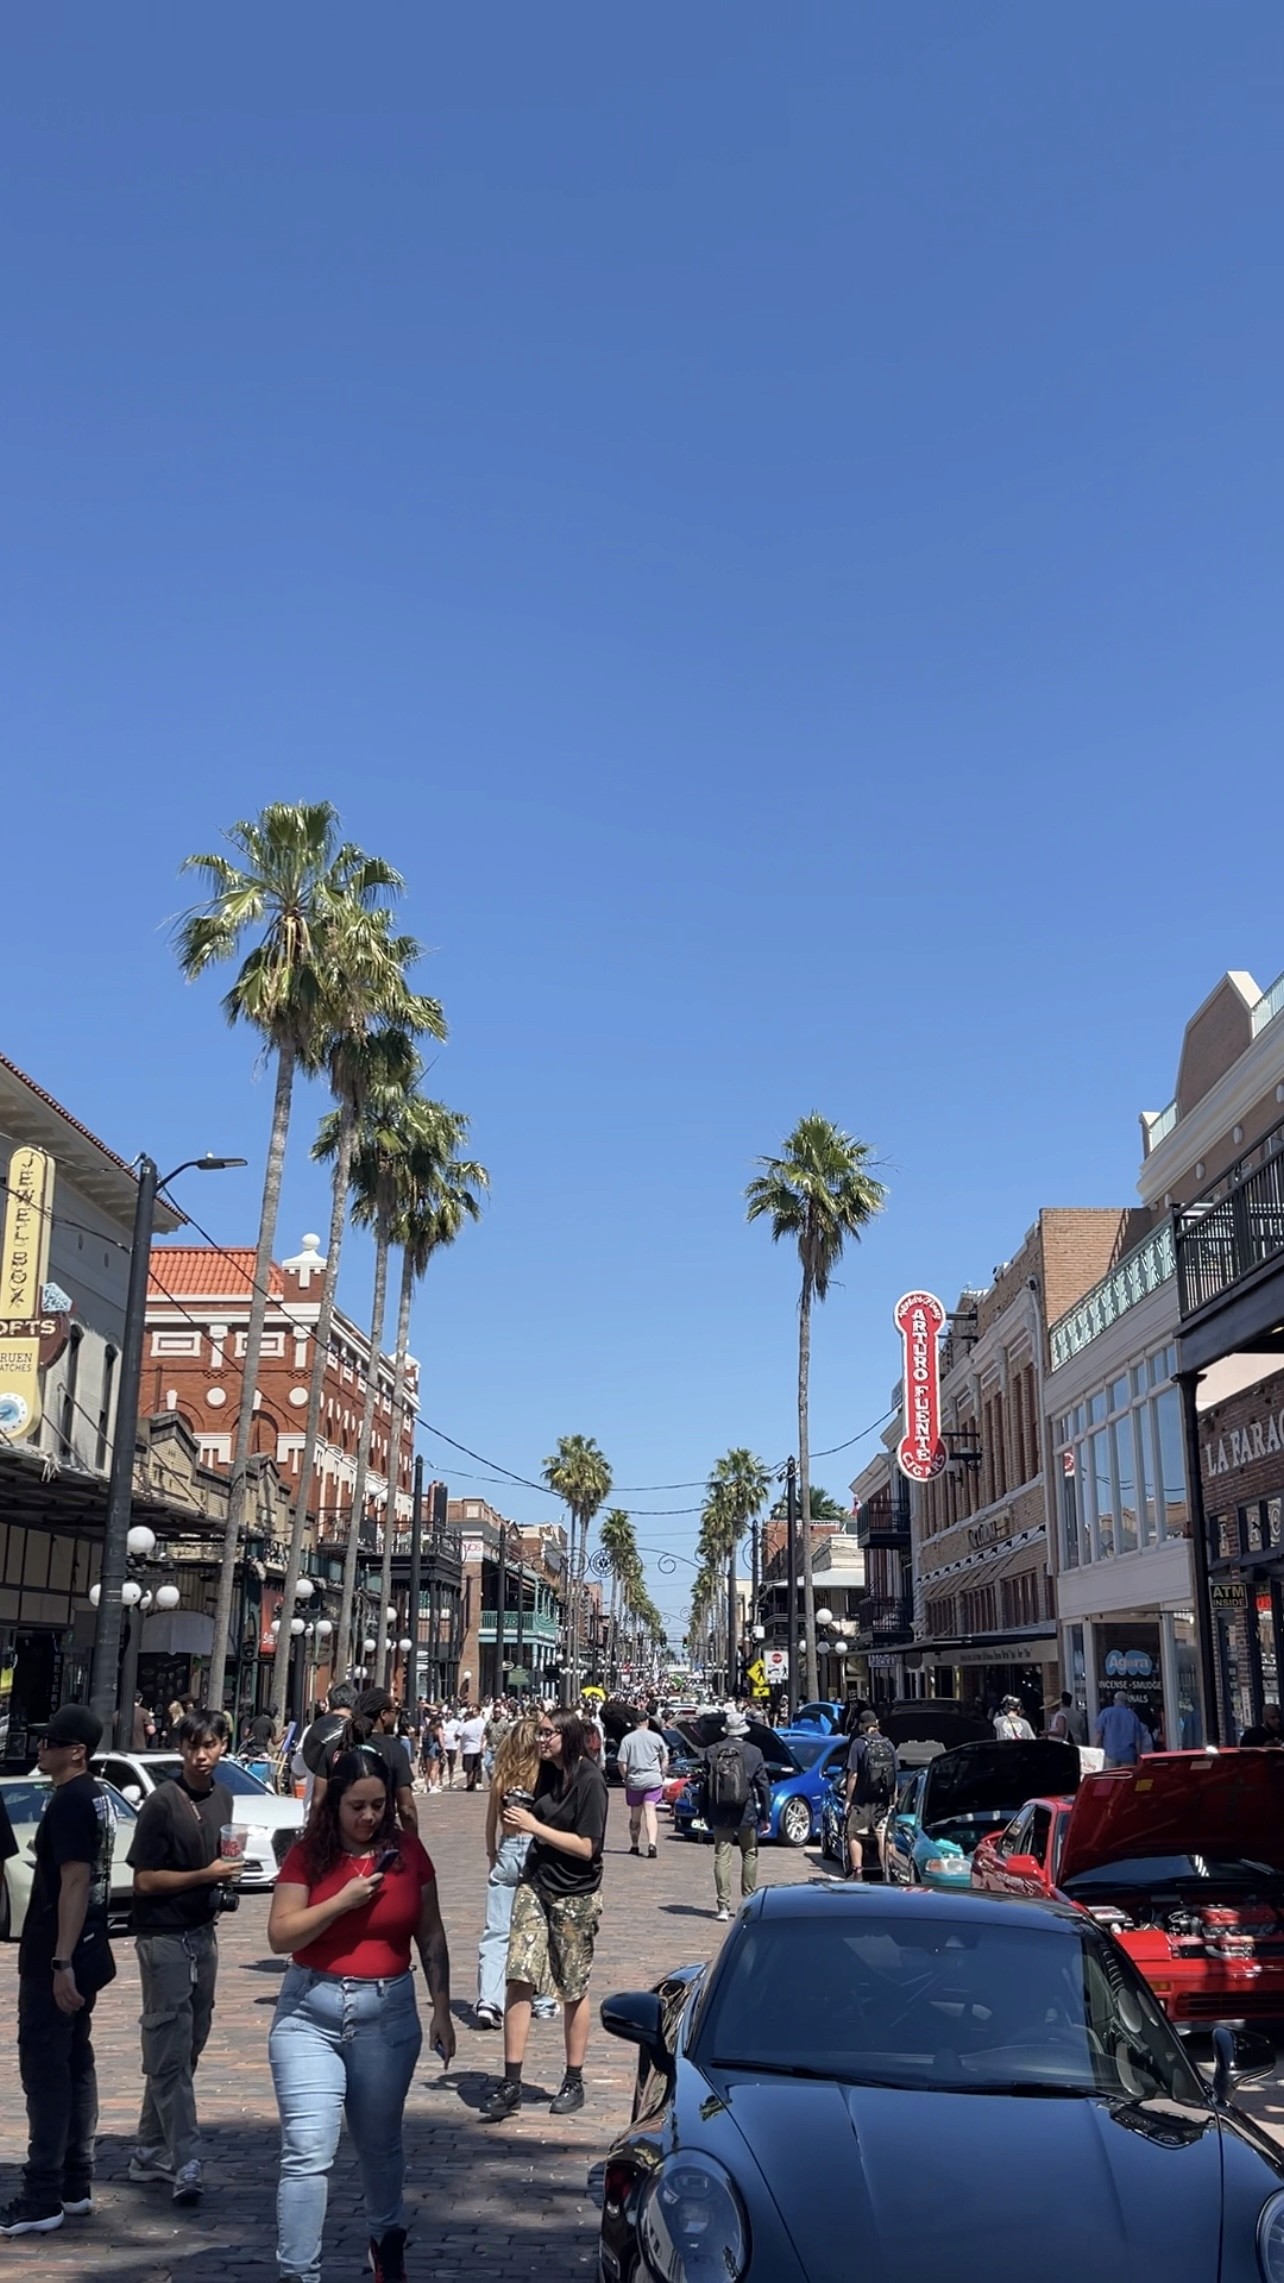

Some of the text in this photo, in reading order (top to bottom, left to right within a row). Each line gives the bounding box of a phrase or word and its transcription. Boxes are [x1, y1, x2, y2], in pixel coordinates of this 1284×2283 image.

[911, 1308, 929, 1383] ARTURO
[914, 1385, 932, 1462] FUENTE
[902, 1451, 945, 1477] CIGARS
[1205, 1439, 1230, 1478] LA
[1213, 1586, 1245, 1598] ATM
[1213, 1599, 1246, 1607] INSIDE
